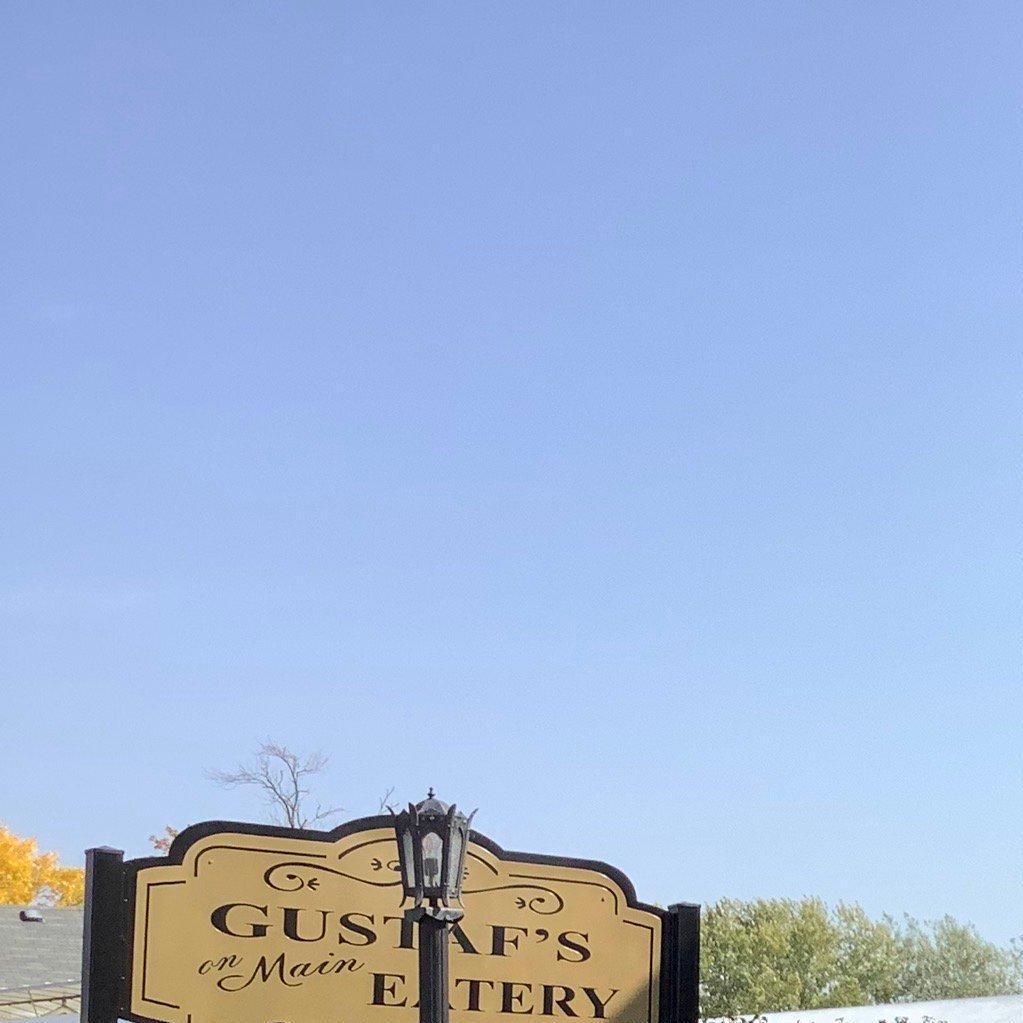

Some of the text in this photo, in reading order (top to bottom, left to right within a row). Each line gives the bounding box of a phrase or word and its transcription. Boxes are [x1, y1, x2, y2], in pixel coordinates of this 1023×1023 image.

[198, 952, 365, 993] on Main
[366, 972, 620, 1019] ETERY
